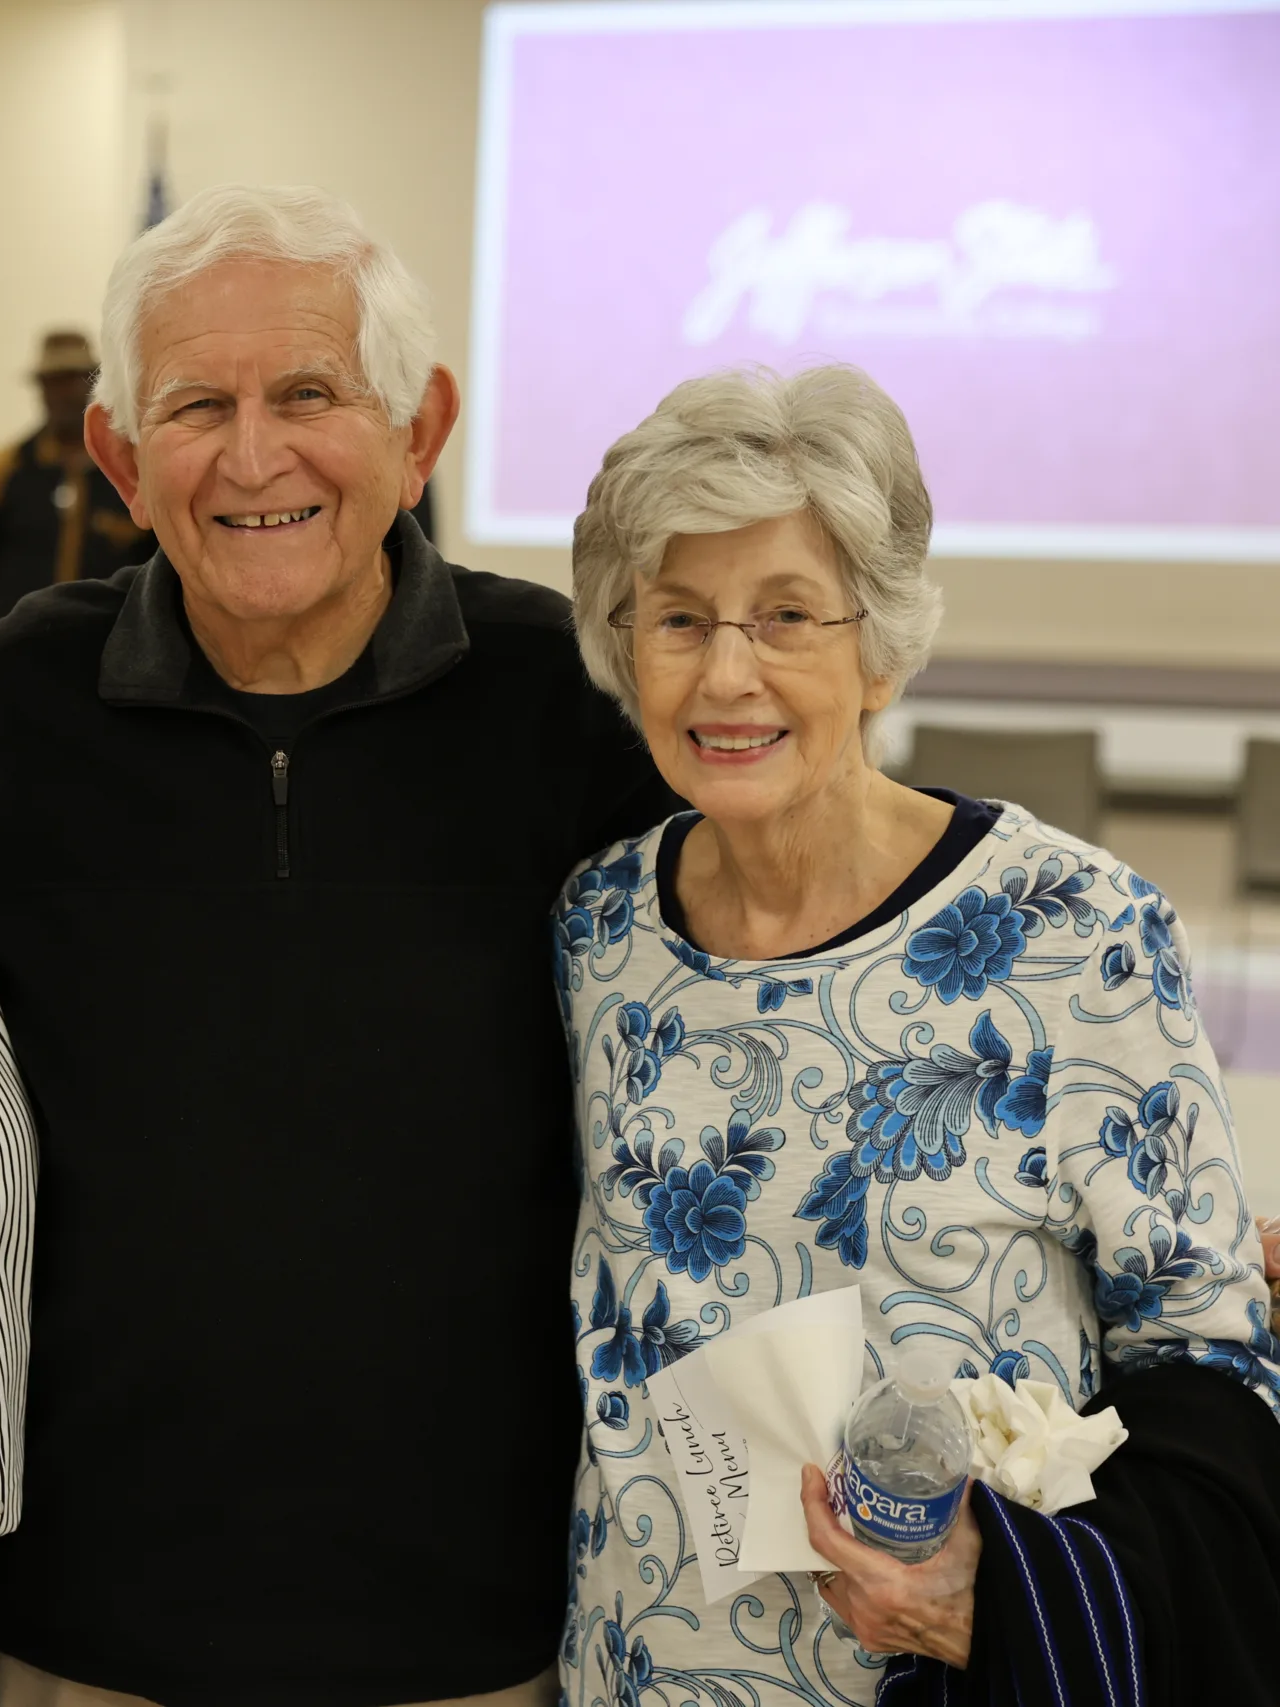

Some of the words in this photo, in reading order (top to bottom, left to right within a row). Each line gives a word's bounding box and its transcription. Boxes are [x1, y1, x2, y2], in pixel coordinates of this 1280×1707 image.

[663, 1402, 714, 1475] Lunch
[711, 1431, 749, 1498] Menu
[706, 1485, 740, 1567] Retiree
[873, 1514, 908, 1533] DRINKING
[909, 1523, 935, 1533] WATER
